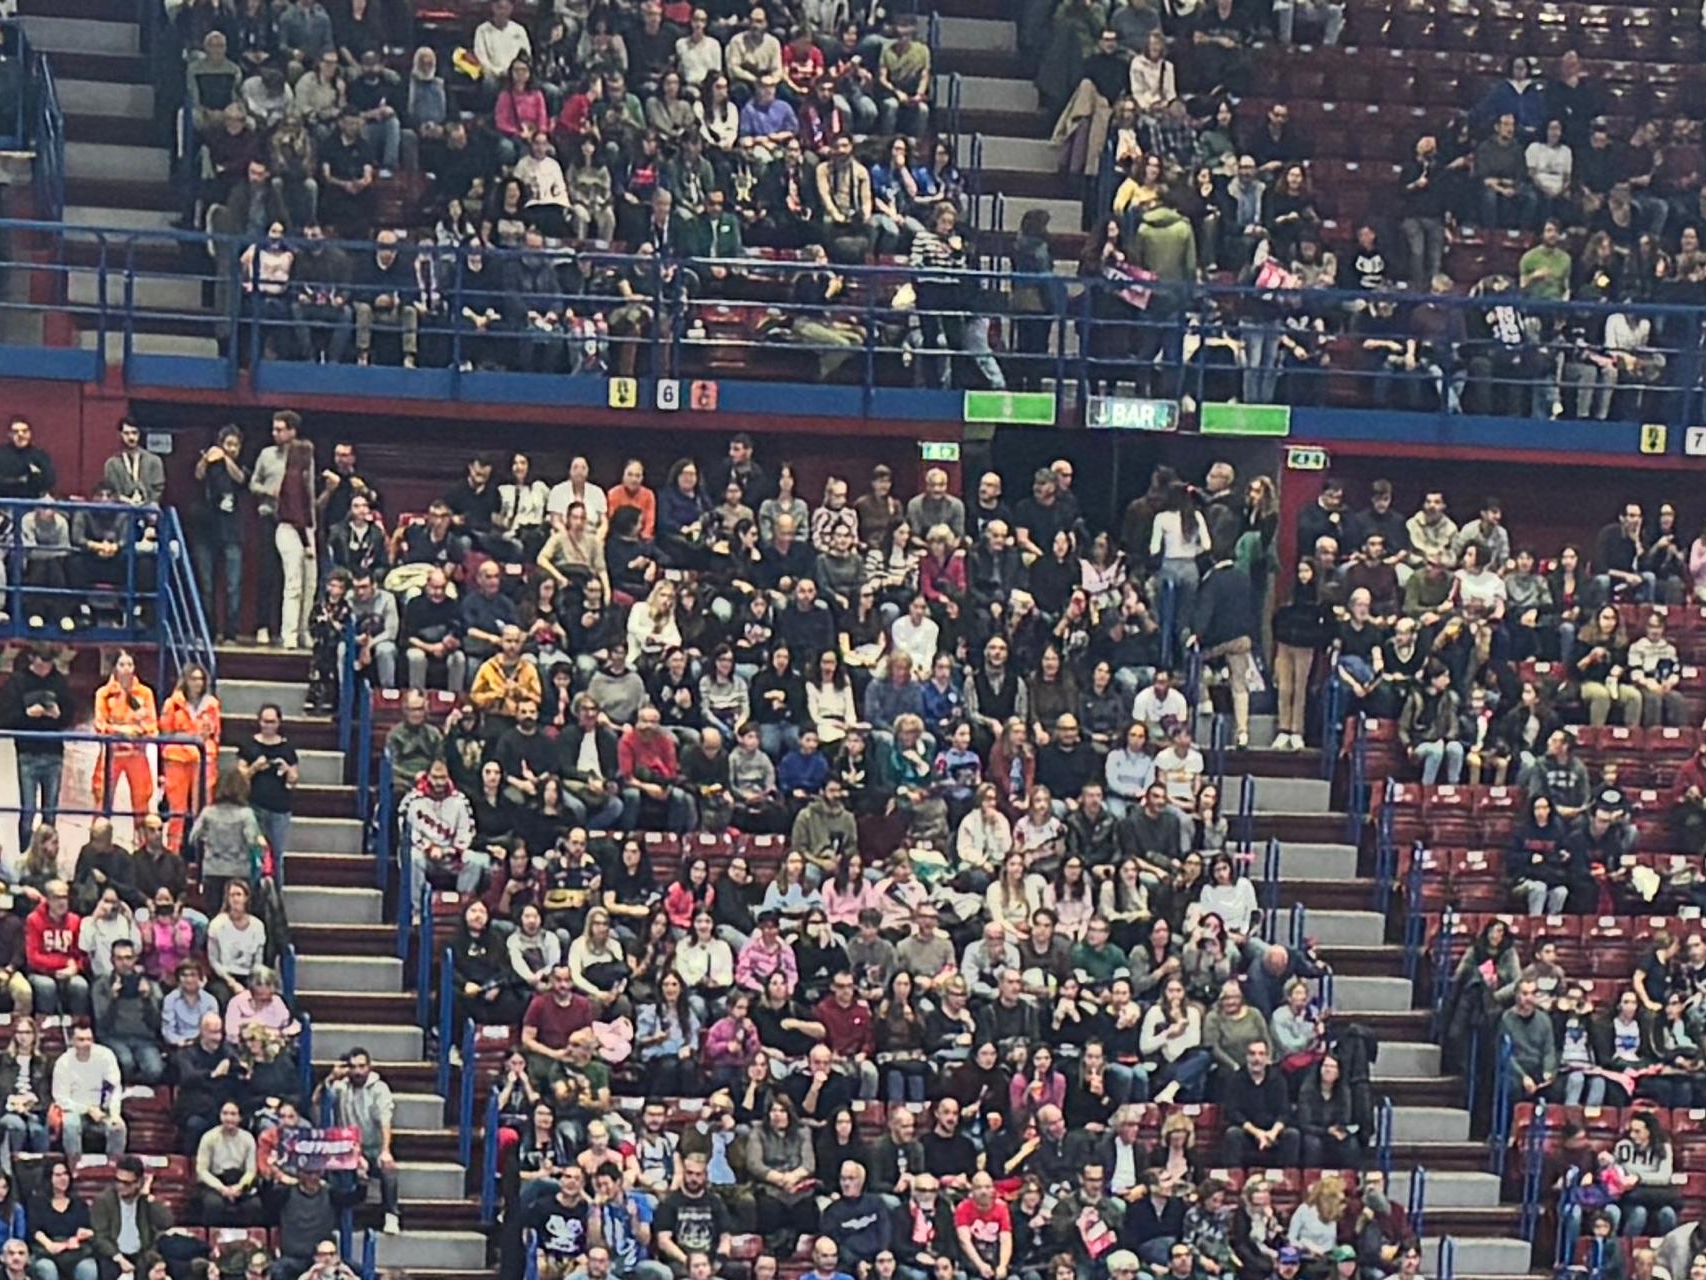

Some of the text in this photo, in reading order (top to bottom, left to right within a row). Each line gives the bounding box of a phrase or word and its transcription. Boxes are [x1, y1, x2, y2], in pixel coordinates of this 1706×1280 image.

[664, 386, 673, 403] 6
[1111, 403, 1156, 428] BAR
[1694, 433, 1704, 448] 7
